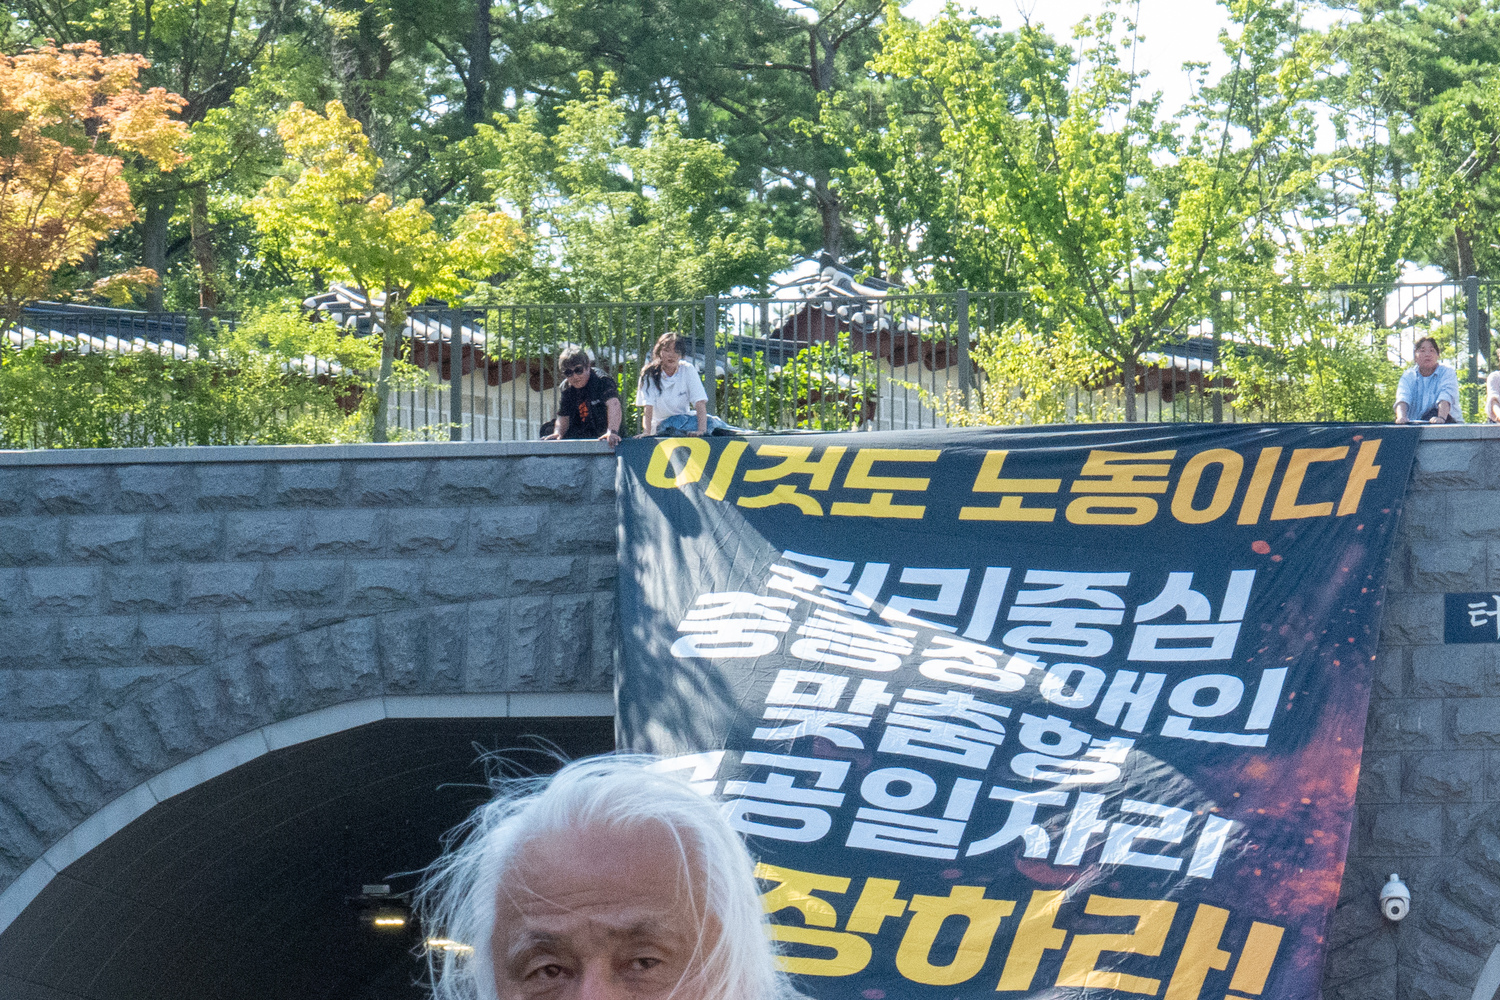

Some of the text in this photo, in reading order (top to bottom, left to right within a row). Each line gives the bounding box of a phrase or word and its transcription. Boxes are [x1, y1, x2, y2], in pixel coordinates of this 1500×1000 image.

[645, 436, 1383, 526] 이것도 노동이다
[767, 550, 1257, 662] 권리중심
[670, 590, 1289, 748] 중증장애인
[751, 669, 1136, 785] 맞춤형
